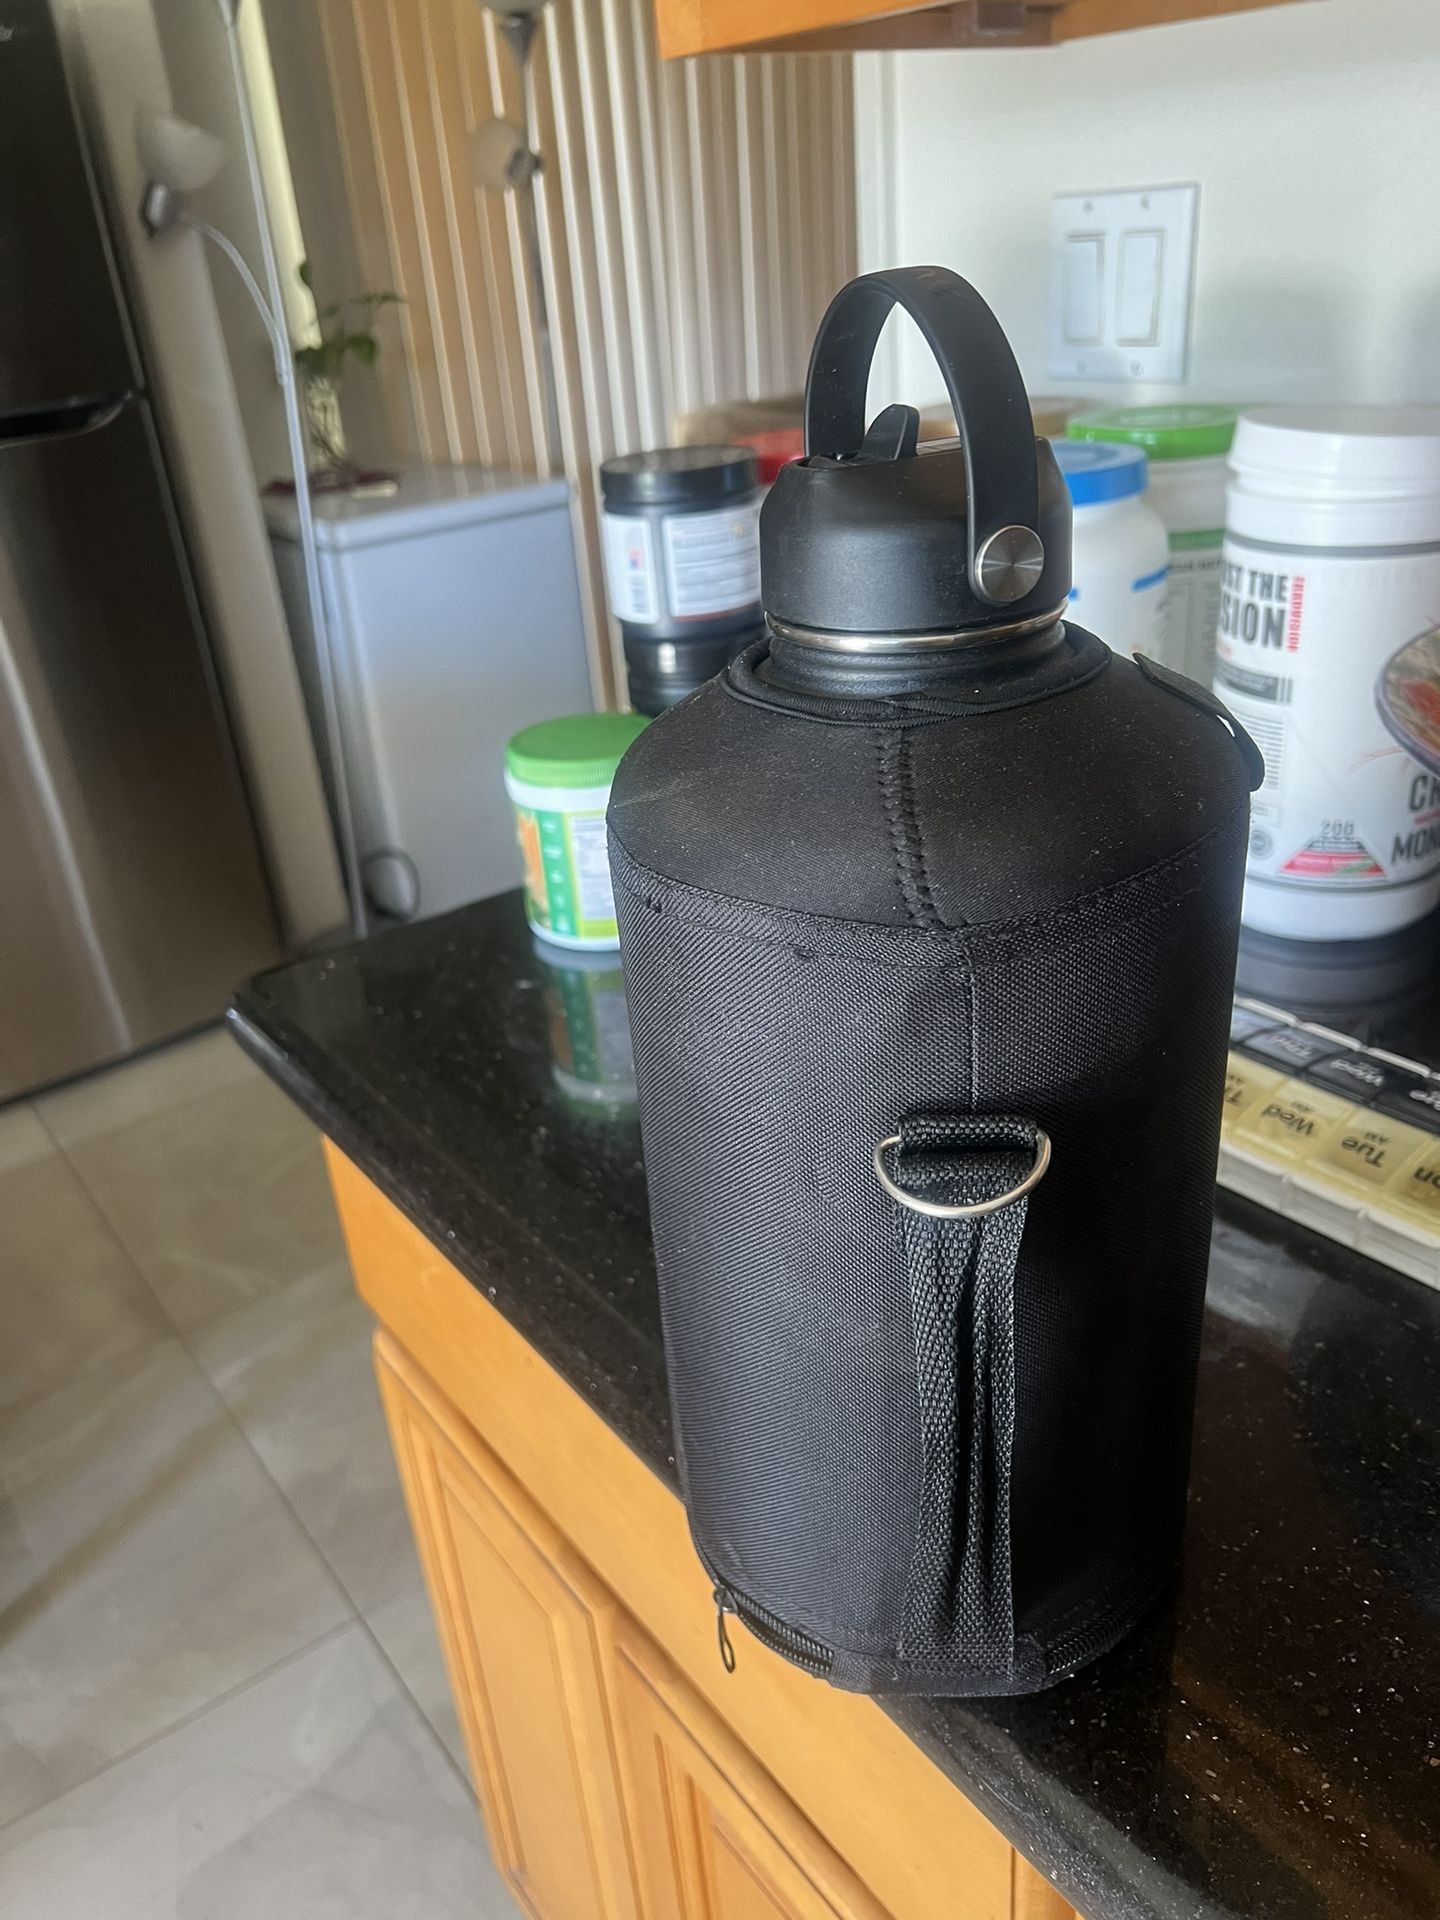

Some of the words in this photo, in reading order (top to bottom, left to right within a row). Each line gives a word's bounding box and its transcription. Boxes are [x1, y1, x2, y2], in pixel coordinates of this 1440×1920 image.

[1248, 569, 1288, 603] THE
[1320, 819, 1354, 838] 200
[1261, 1102, 1314, 1136] Wed
[1341, 1135, 1386, 1168] Tue
